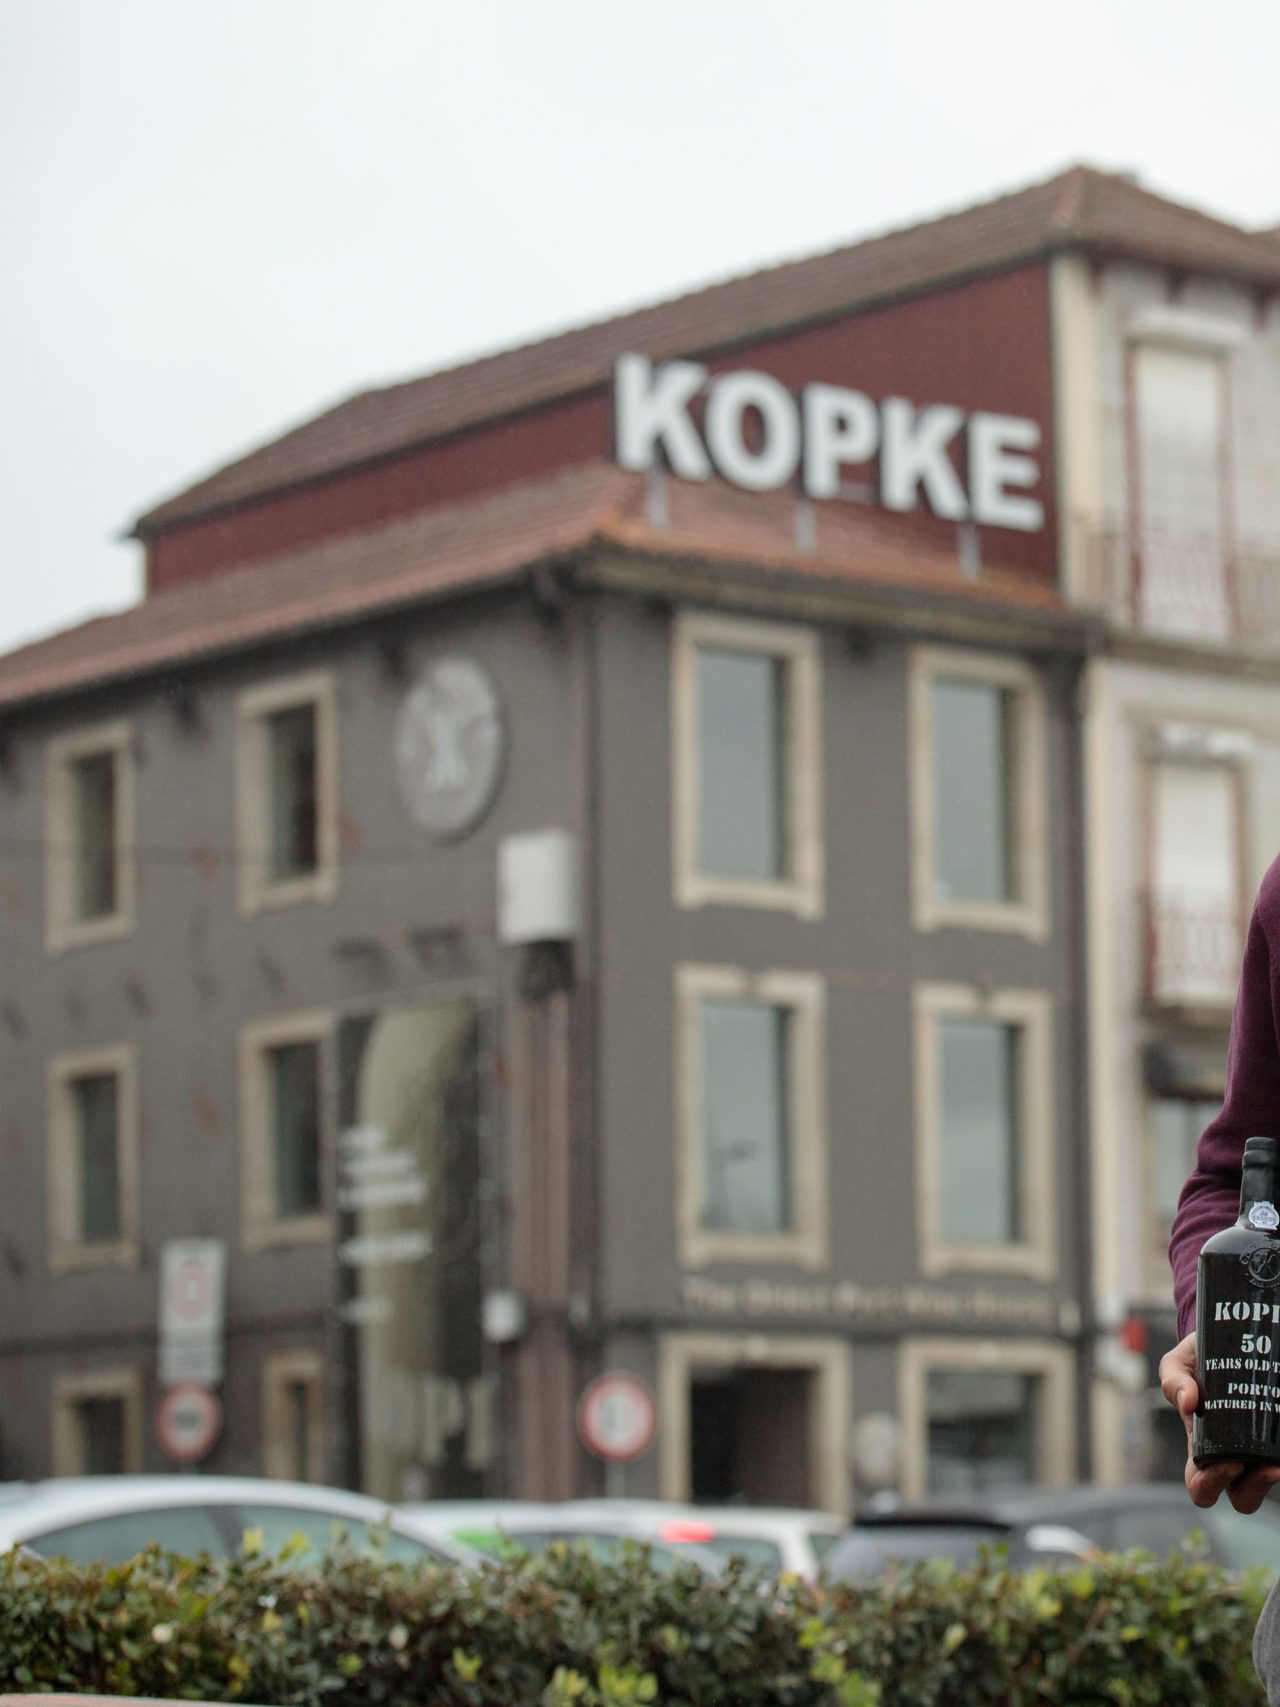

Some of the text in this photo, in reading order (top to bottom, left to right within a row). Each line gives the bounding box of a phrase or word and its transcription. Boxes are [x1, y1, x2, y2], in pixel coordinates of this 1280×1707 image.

[615, 352, 1044, 533] KOPKE
[1241, 1333, 1272, 1354] 50
[1205, 1358, 1242, 1371] YEARS
[1244, 1358, 1270, 1372] OLD
[1227, 1382, 1280, 1398] PORTO
[1204, 1399, 1256, 1411] MATURED
[1259, 1401, 1272, 1412] IN
